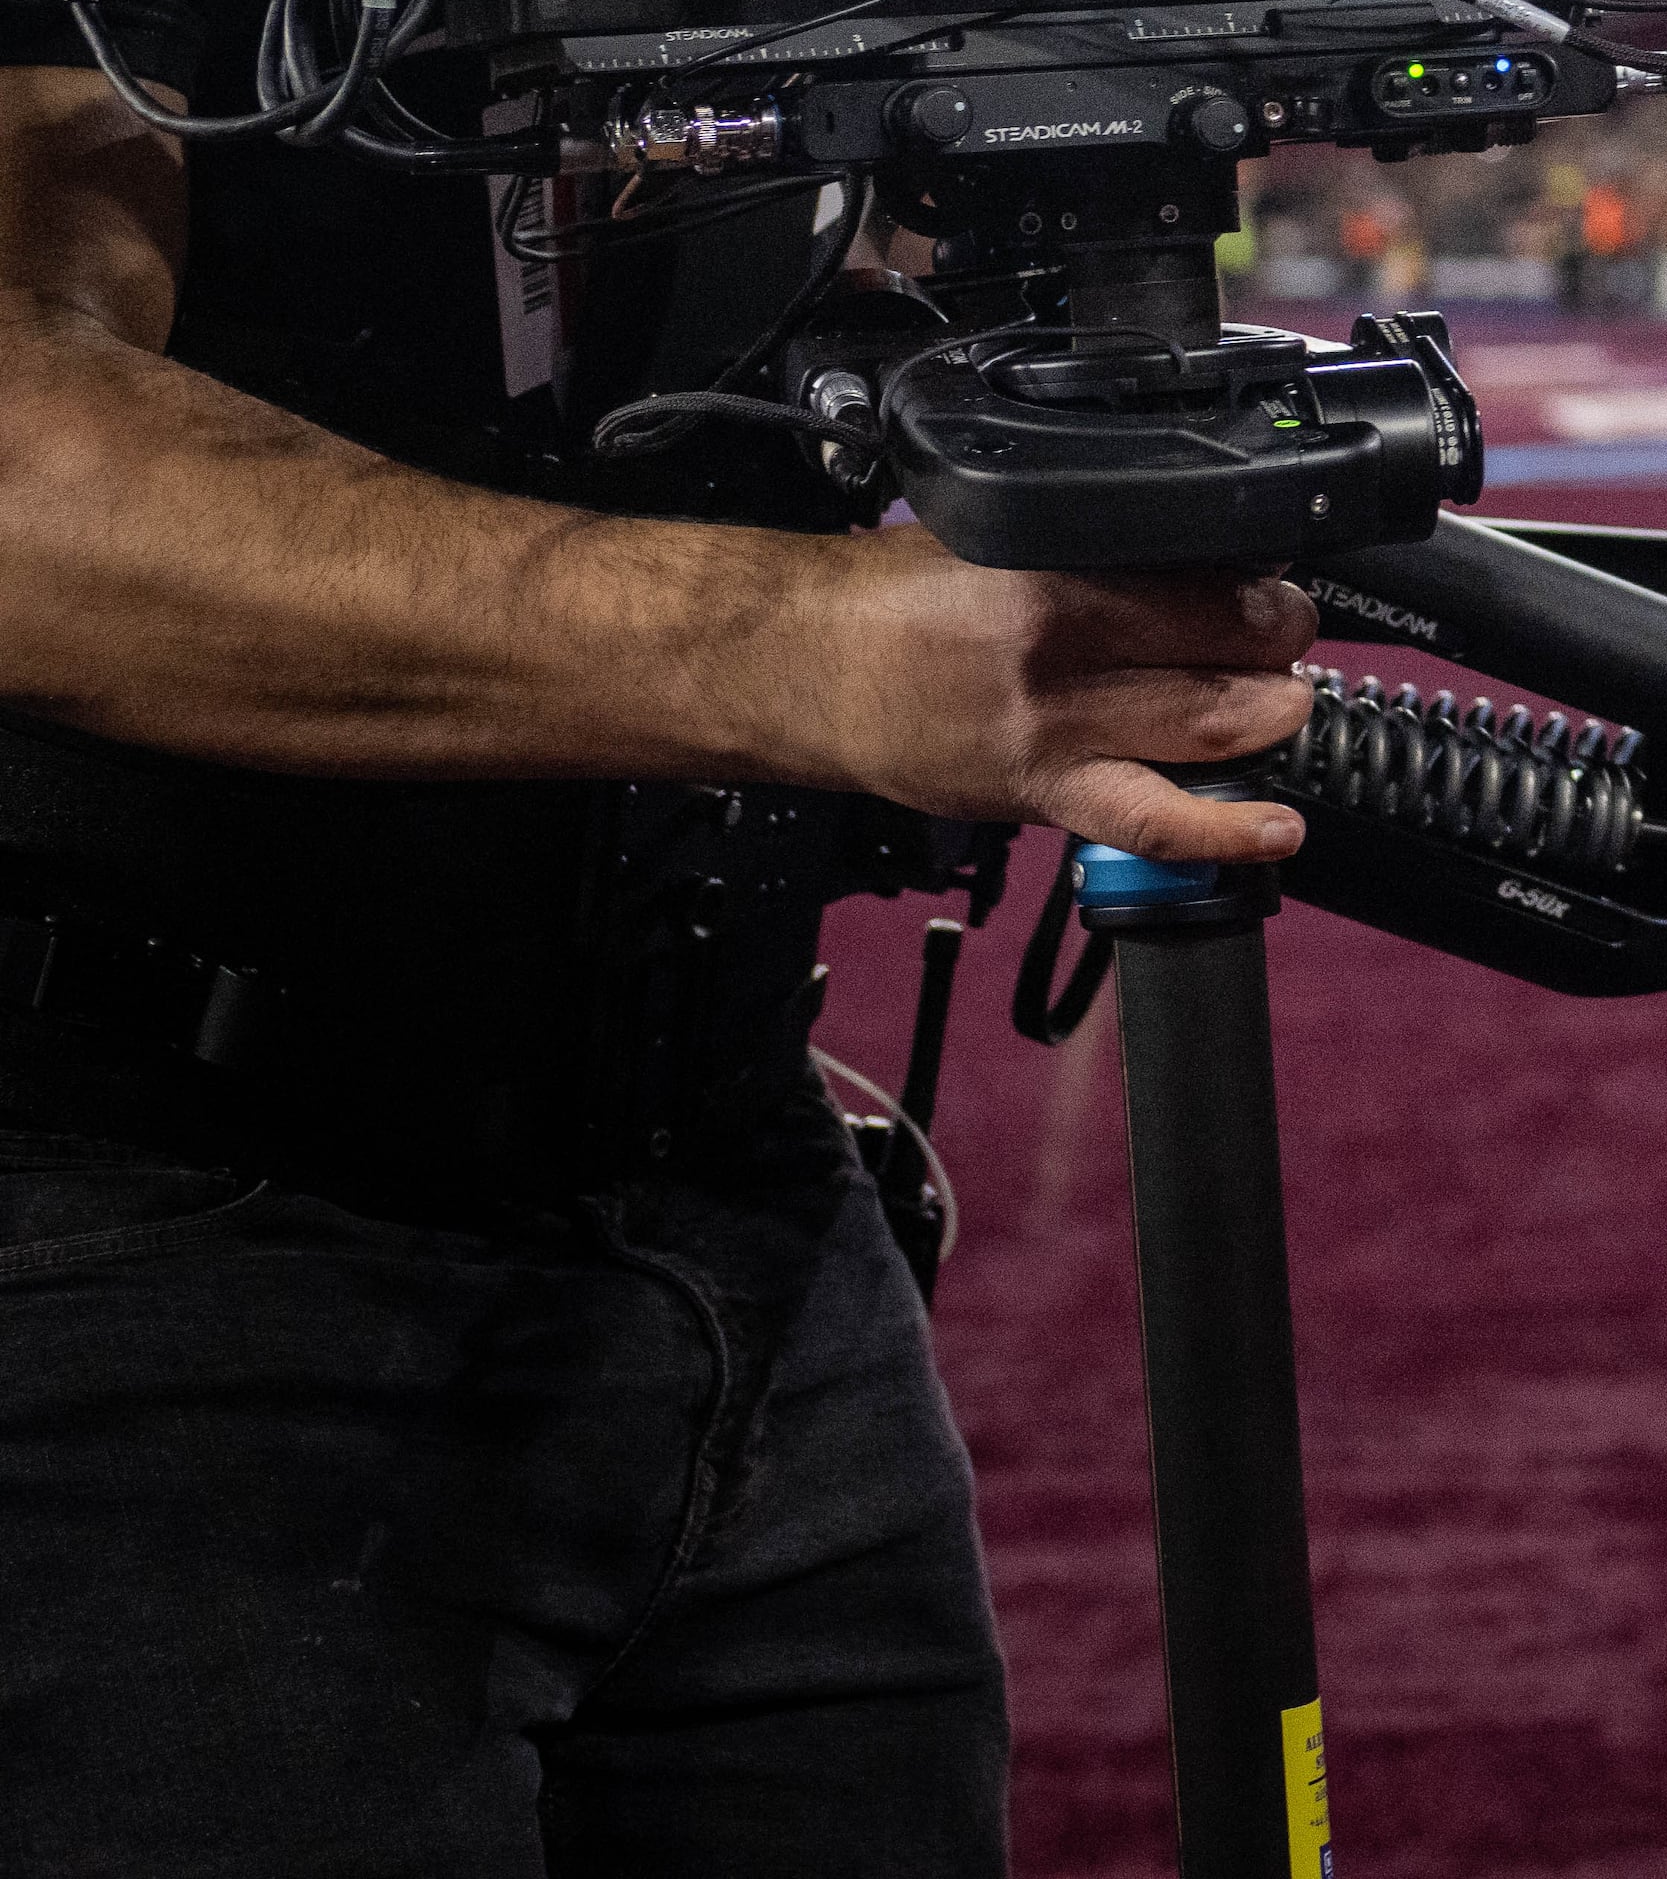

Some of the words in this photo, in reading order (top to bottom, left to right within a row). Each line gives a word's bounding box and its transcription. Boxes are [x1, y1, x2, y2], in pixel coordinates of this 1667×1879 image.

[665, 28, 749, 41] STEADICAM
[984, 121, 1101, 144] STEADICAM
[1102, 119, 1144, 136] M-2
[1308, 577, 1438, 641] STEADICAM
